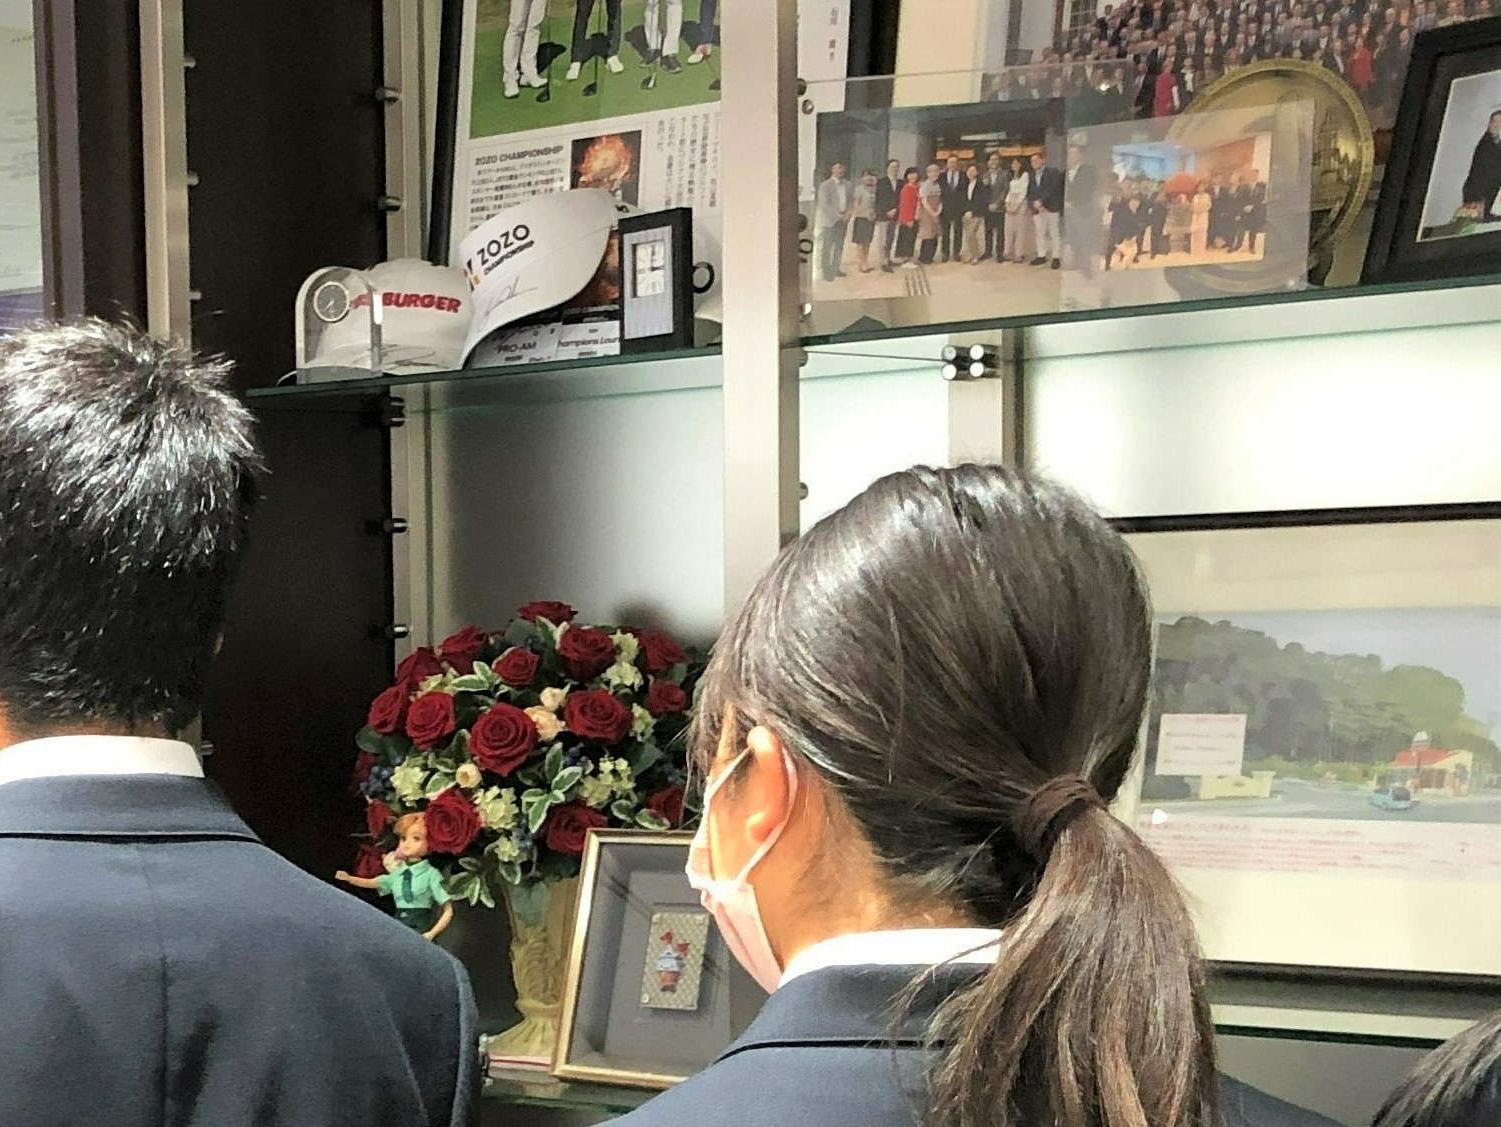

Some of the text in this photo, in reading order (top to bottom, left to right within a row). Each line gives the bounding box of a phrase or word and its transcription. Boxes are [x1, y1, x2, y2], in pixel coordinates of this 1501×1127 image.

[499, 145, 563, 162] CHAMPIONSHIP
[477, 224, 530, 266] ZOZO
[382, 292, 461, 313] BURGER
[497, 341, 537, 354] PRO-AM
